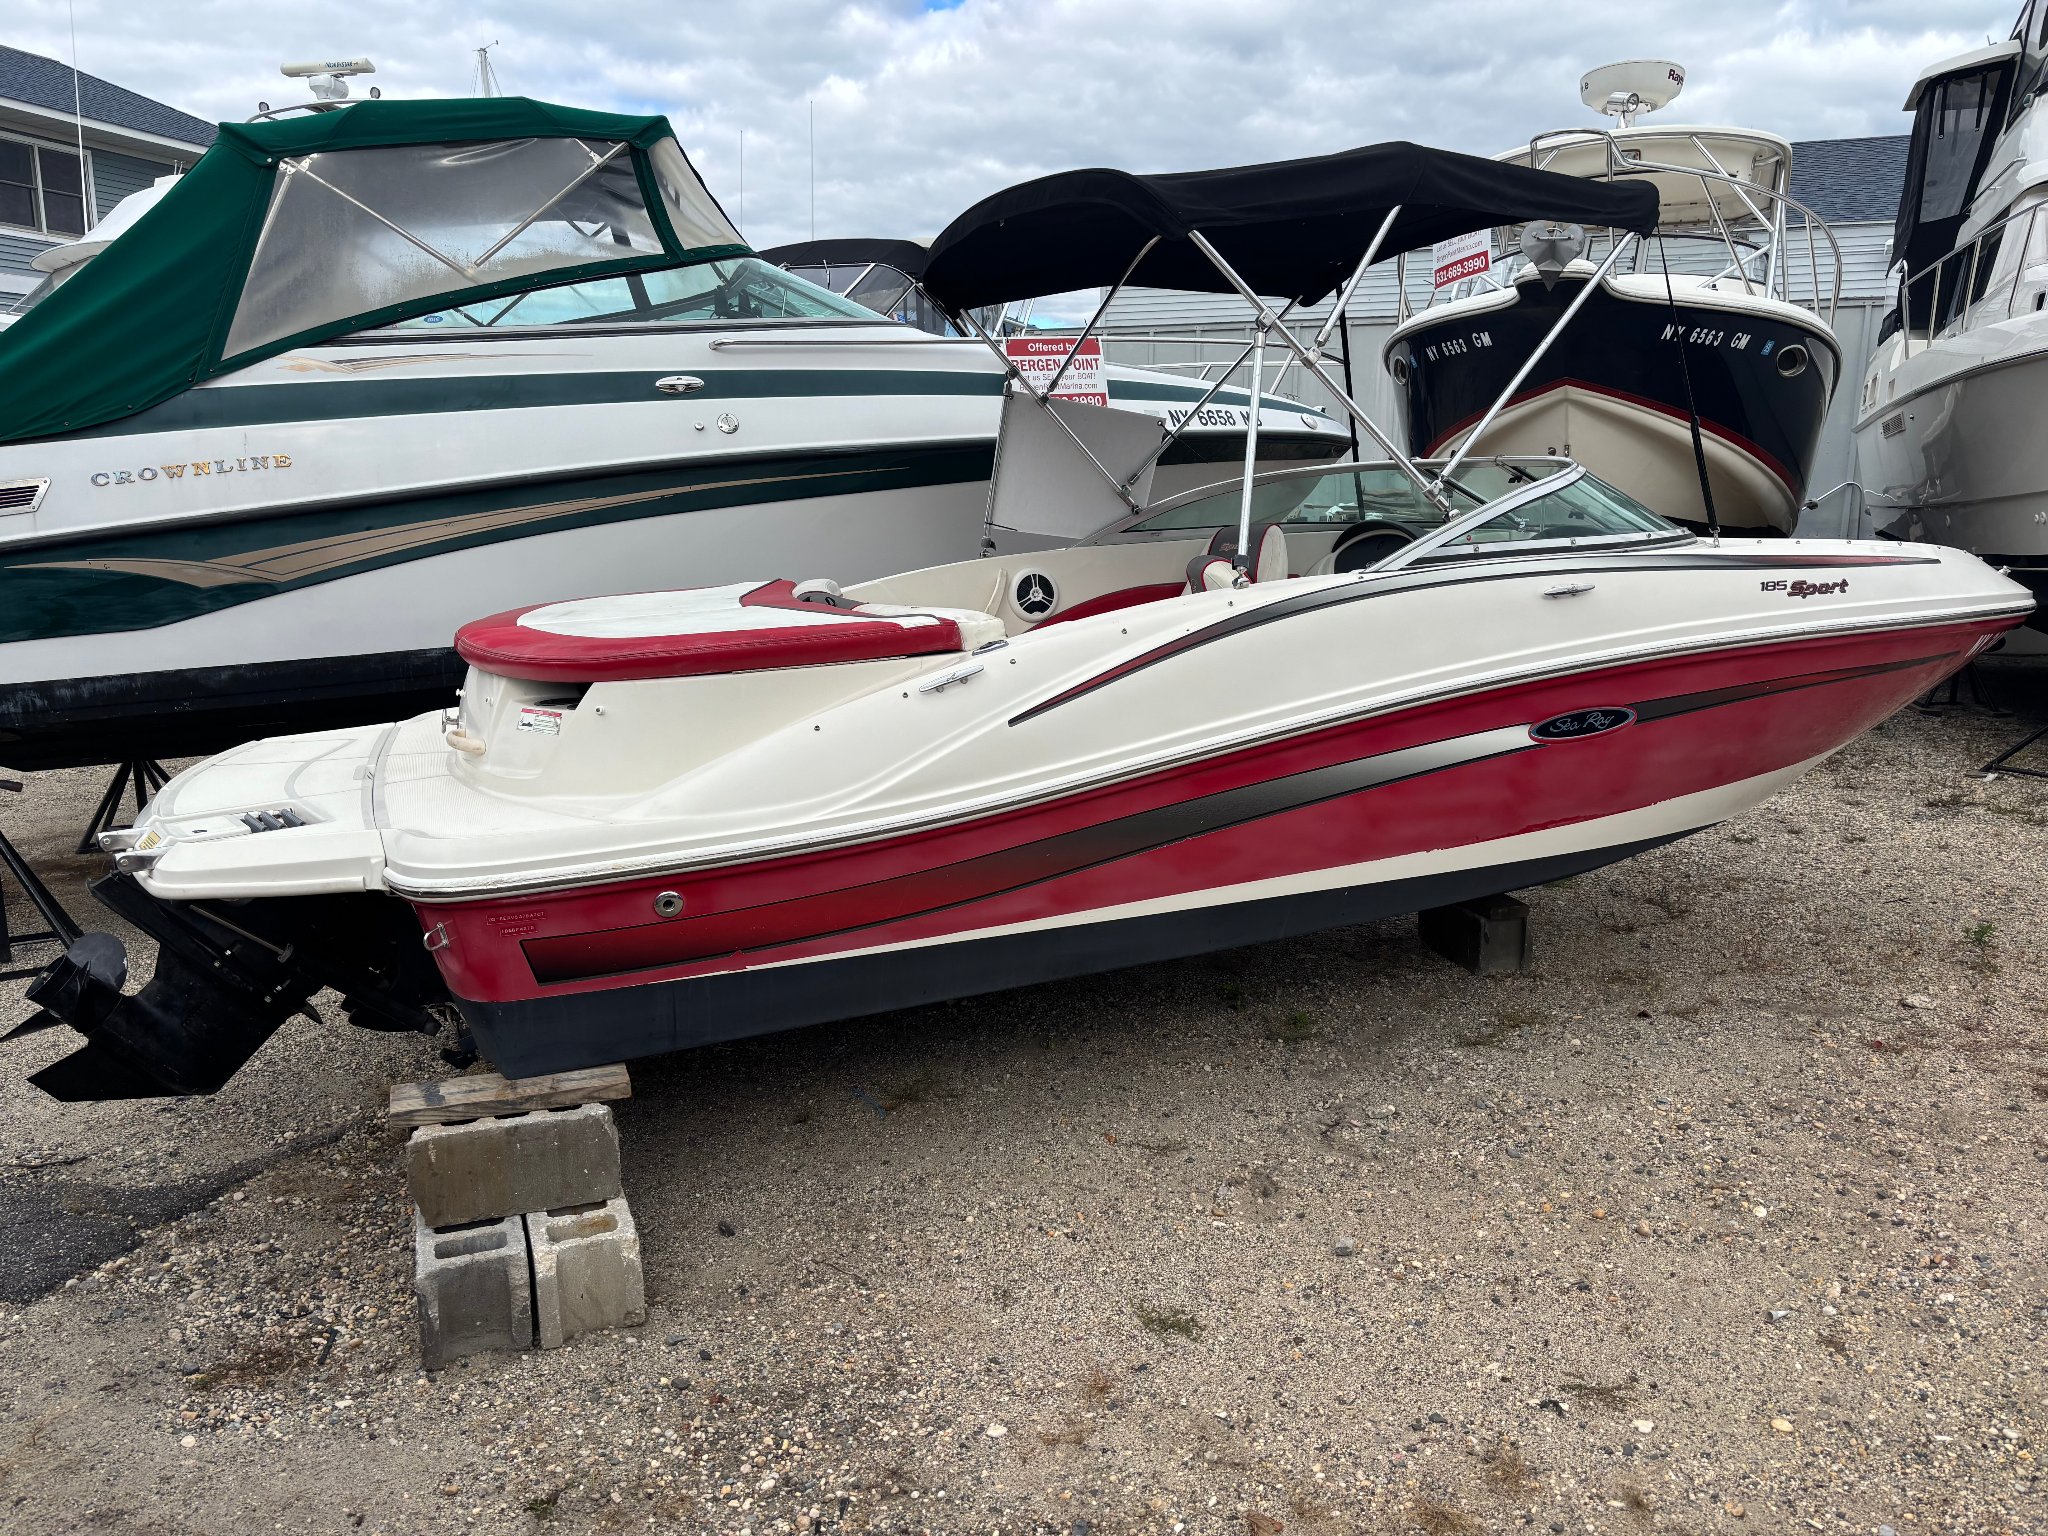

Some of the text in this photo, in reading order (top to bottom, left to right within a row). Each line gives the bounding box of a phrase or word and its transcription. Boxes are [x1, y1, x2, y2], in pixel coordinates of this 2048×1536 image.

[1436, 256, 1486, 284] 631-669-3990
[1028, 343, 1064, 351] Offered
[1426, 346, 1440, 361] NY
[1441, 338, 1468, 356] 6563
[1471, 331, 1493, 348] GM
[1661, 324, 1686, 341] NY
[1689, 328, 1724, 347] 6563
[1730, 332, 1752, 350] GM
[1066, 358, 1100, 370] OINT
[1077, 372, 1097, 380] BOAT!
[1197, 409, 1236, 427] 6658
[90, 453, 293, 487] CROWNLINE
[1760, 578, 1849, 599] 185 Sport
[1549, 711, 1615, 733] Sea Ray
